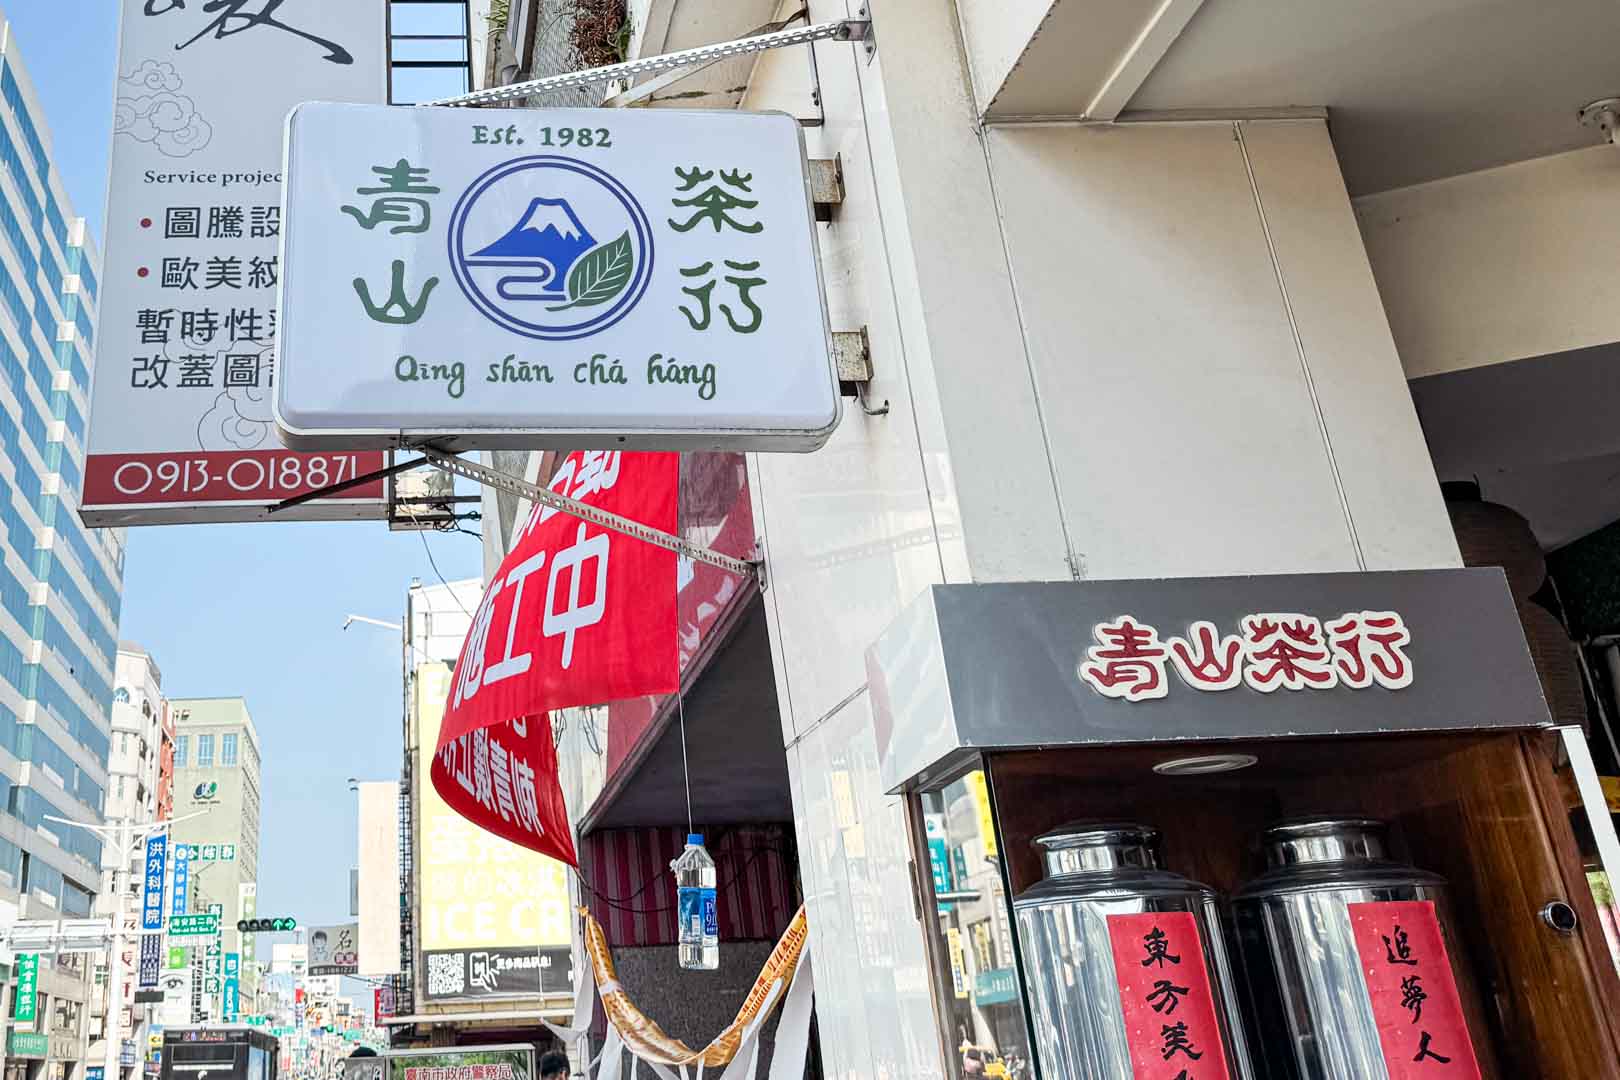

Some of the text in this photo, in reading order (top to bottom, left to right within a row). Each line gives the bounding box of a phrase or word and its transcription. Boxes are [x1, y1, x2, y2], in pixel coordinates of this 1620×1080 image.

[472, 125, 613, 148] Est. 1982
[144, 170, 217, 185] Service
[340, 158, 441, 325] 青山
[131, 353, 275, 390] 改蓋圖
[113, 455, 357, 496] 0913-018871
[1082, 612, 1412, 700] 青山茶行
[145, 841, 164, 925] 洪外科醫院
[430, 901, 497, 940] ICE
[1141, 926, 1203, 1080] 東方美
[1382, 925, 1452, 1065] 追夢人
